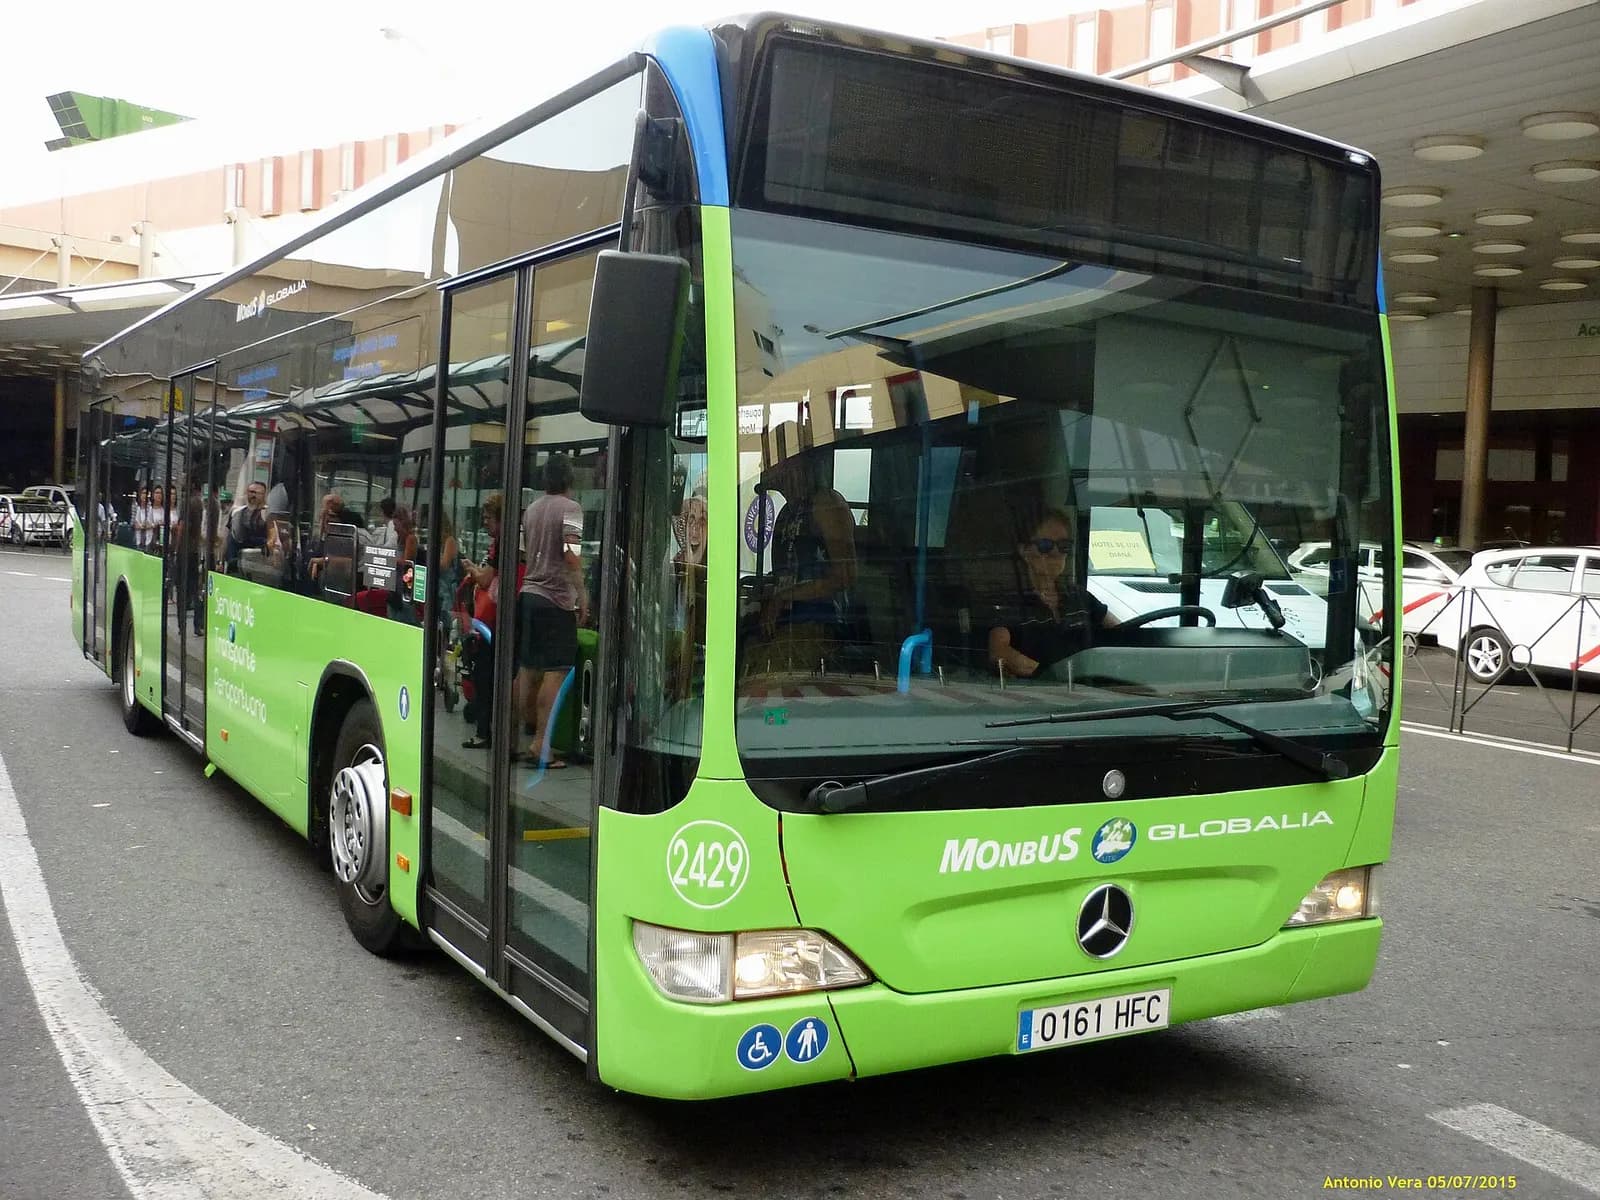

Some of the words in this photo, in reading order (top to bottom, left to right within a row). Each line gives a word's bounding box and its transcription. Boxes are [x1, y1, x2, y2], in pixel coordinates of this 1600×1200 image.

[267, 279, 307, 305] GLOBALIA
[214, 588, 242, 623] Servicio
[244, 598, 256, 628] de
[214, 626, 256, 673] Transporte
[214, 667, 267, 723] Aeroportuario
[1148, 810, 1334, 842] GLOBALIA
[673, 838, 744, 888] 2429
[1022, 1034, 1029, 1044] E
[1041, 1003, 1102, 1042] 0161
[1115, 994, 1161, 1030] HFC
